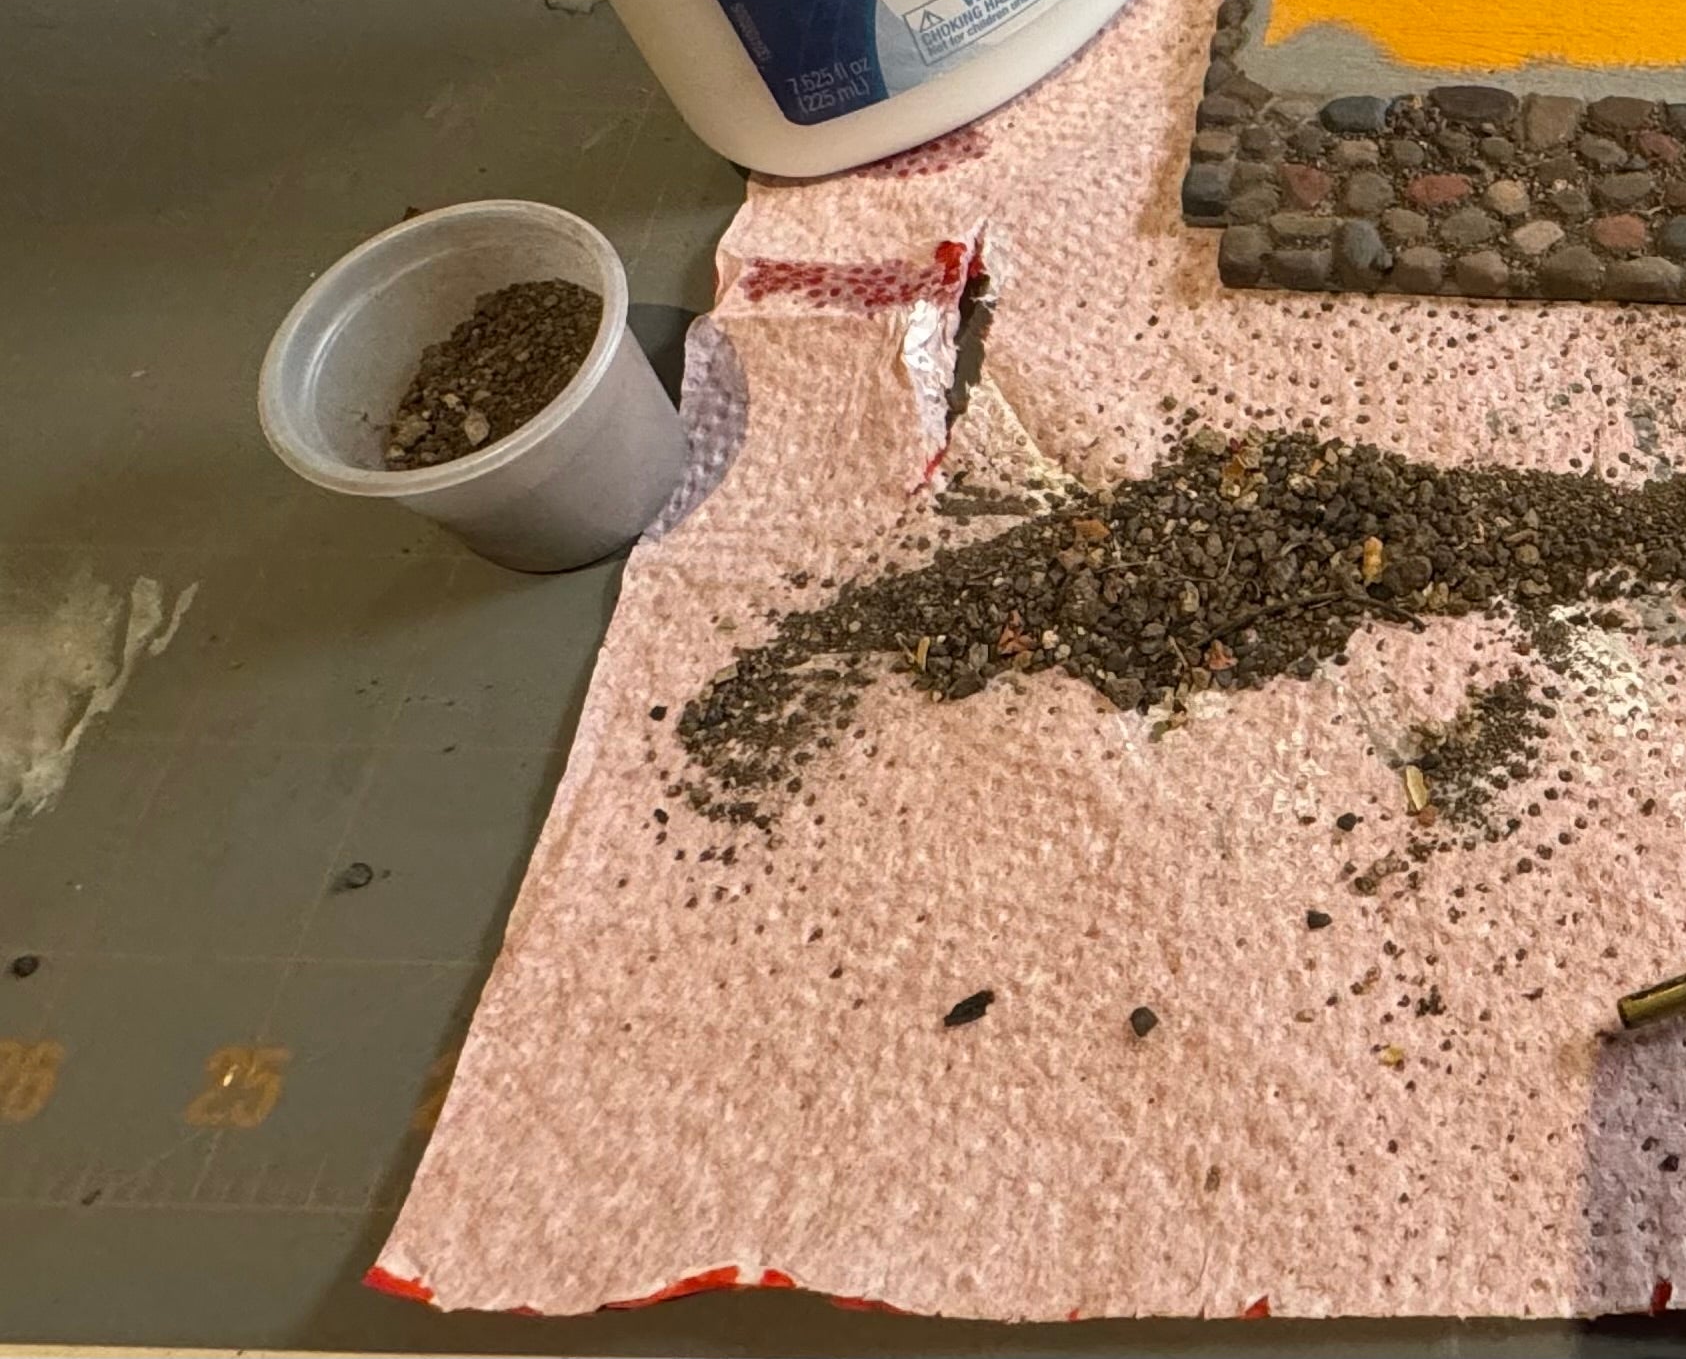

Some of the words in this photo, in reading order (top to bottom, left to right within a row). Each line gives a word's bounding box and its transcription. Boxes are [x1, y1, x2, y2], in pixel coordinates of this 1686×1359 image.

[920, 6, 983, 44] CHOKING
[949, 32, 966, 46] for
[967, 3, 1010, 37] children
[850, 57, 872, 75] oz
[799, 90, 836, 114] (225
